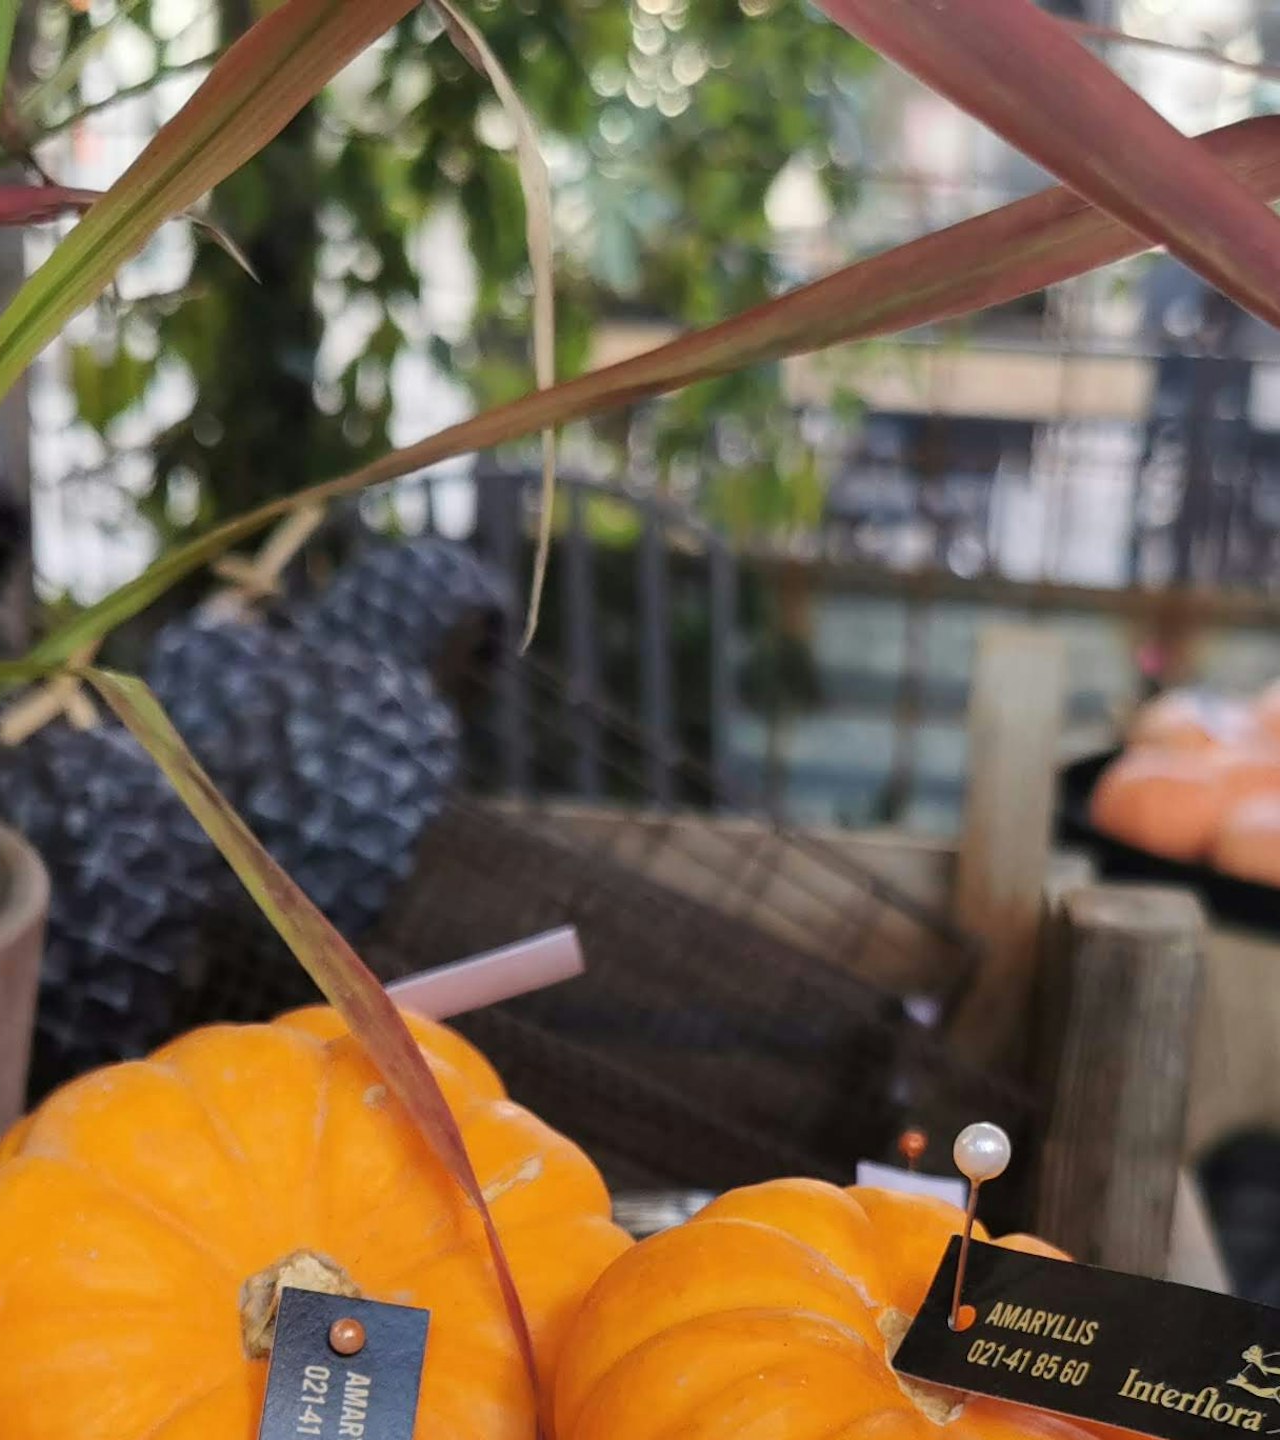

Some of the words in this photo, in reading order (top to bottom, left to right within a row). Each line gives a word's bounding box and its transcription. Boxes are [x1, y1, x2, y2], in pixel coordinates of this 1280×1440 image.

[984, 1301, 1099, 1345] AMARYLLIS
[966, 1339, 1032, 1374] 021-41
[1031, 1353, 1062, 1380] 85
[1059, 1359, 1090, 1386] 60
[296, 1365, 331, 1435] 021-41
[1117, 1367, 1263, 1432] Interflora
